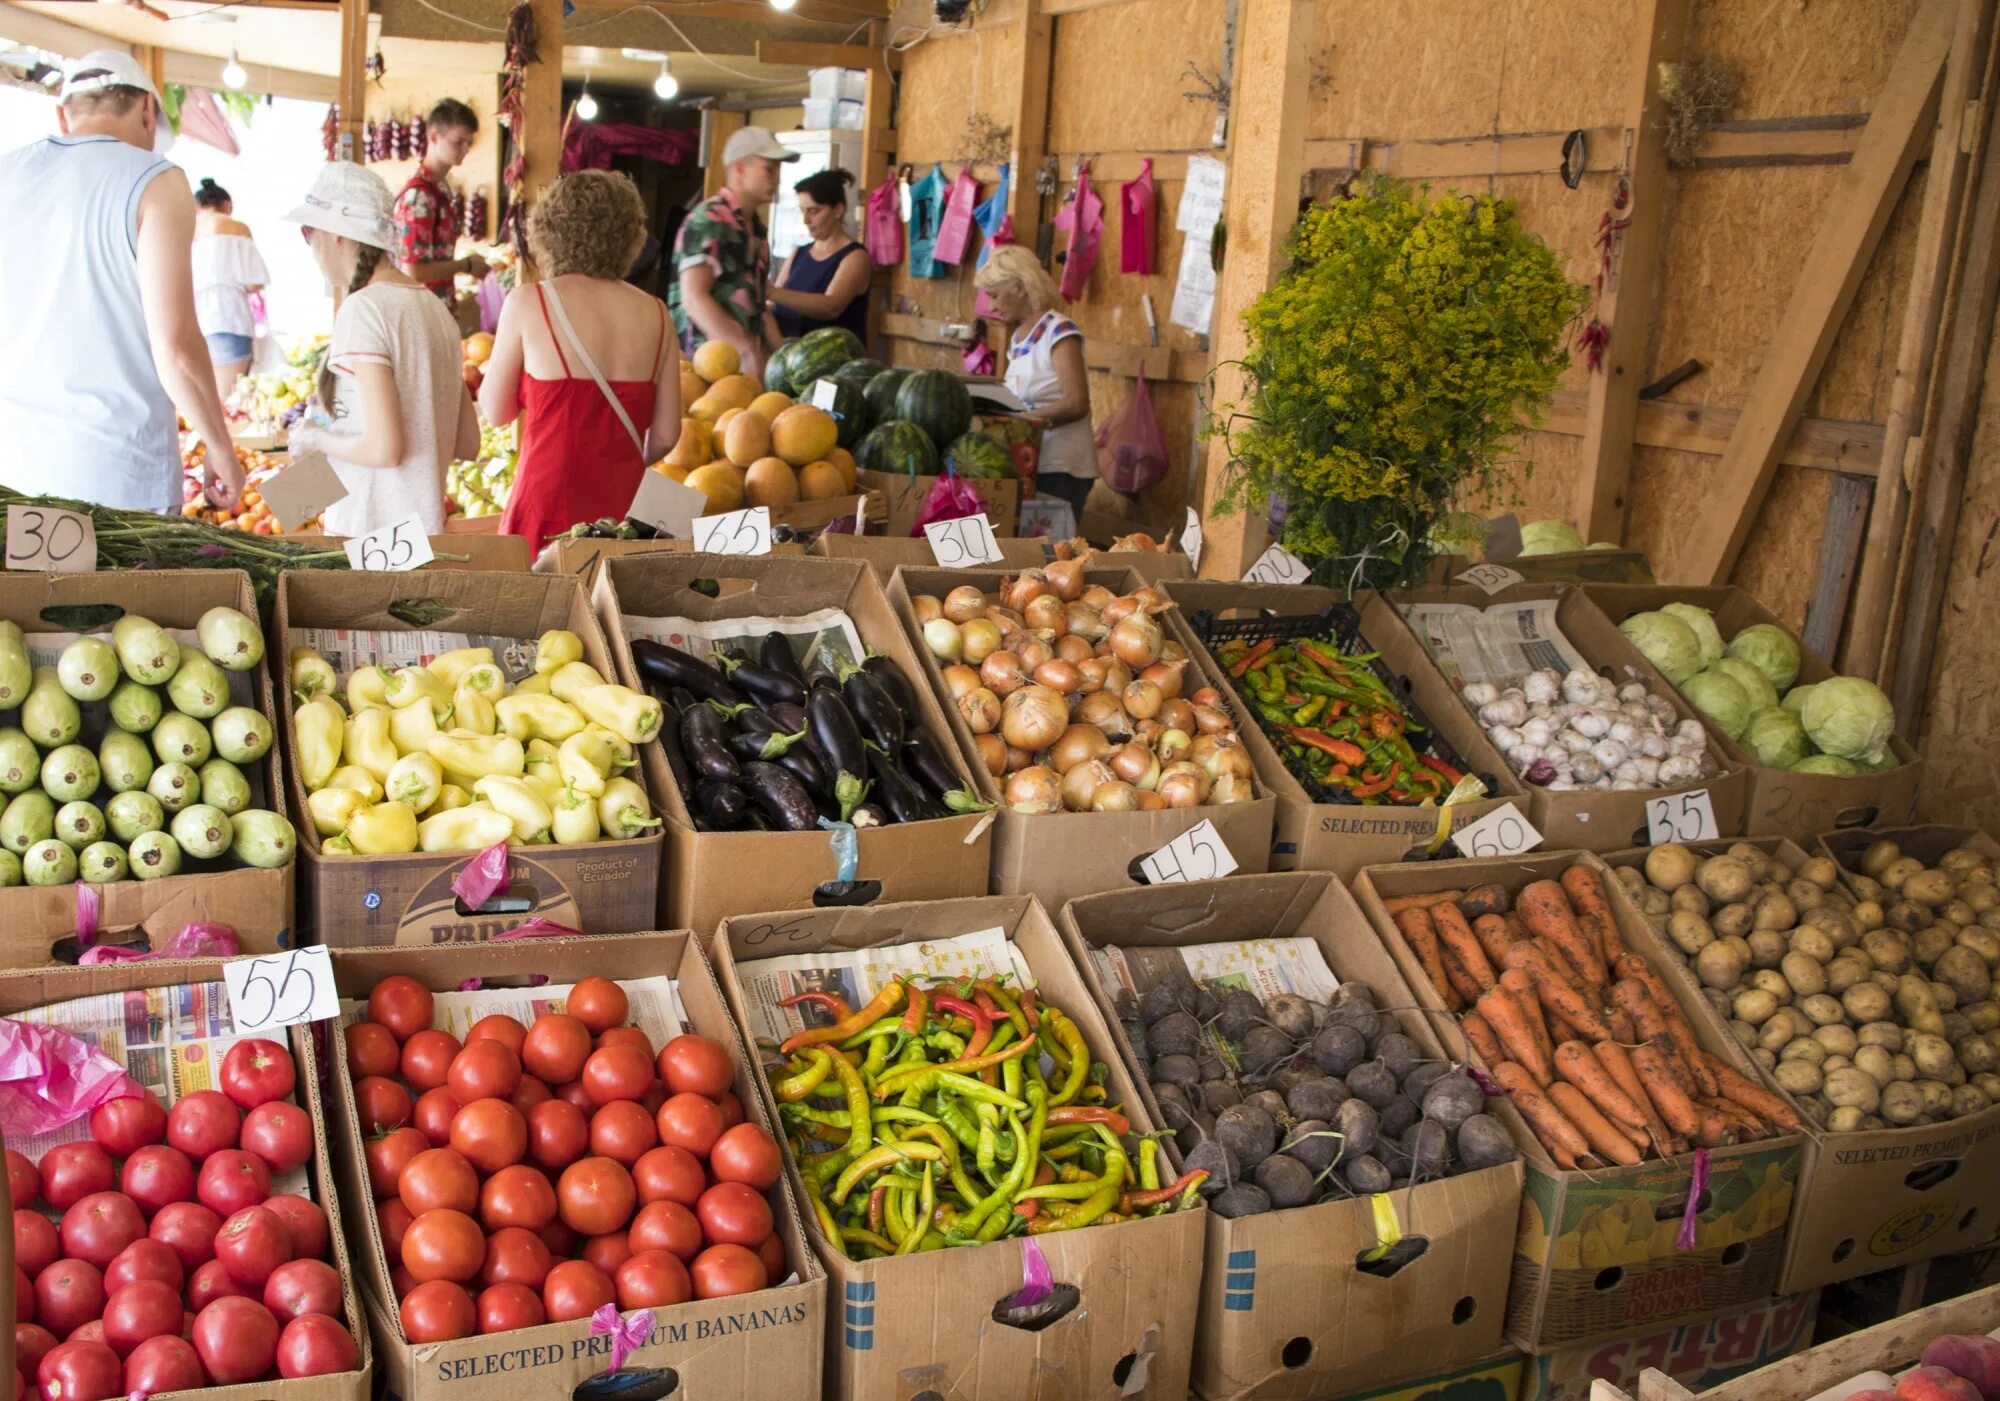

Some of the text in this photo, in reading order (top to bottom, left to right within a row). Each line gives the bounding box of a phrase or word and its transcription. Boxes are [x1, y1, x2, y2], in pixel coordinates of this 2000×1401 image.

[9, 510, 84, 561] 30
[361, 520, 413, 571] 65
[703, 507, 768, 555] 65
[929, 518, 991, 563] 30
[1468, 566, 1508, 585] 130
[1320, 817, 1400, 835] SELECTED
[1403, 815, 1468, 836] PREM
[1472, 817, 1525, 856] 60
[1656, 791, 1706, 843] 35
[576, 857, 638, 873] Product of
[583, 870, 632, 882] Ecuador
[1151, 822, 1217, 882] 45
[240, 949, 323, 1027] 55
[170, 1048, 182, 1102] АМЯТНИКИ
[1833, 1145, 1910, 1165] SELECTED
[438, 1302, 807, 1382] SELECTED PREUM BANANAS
